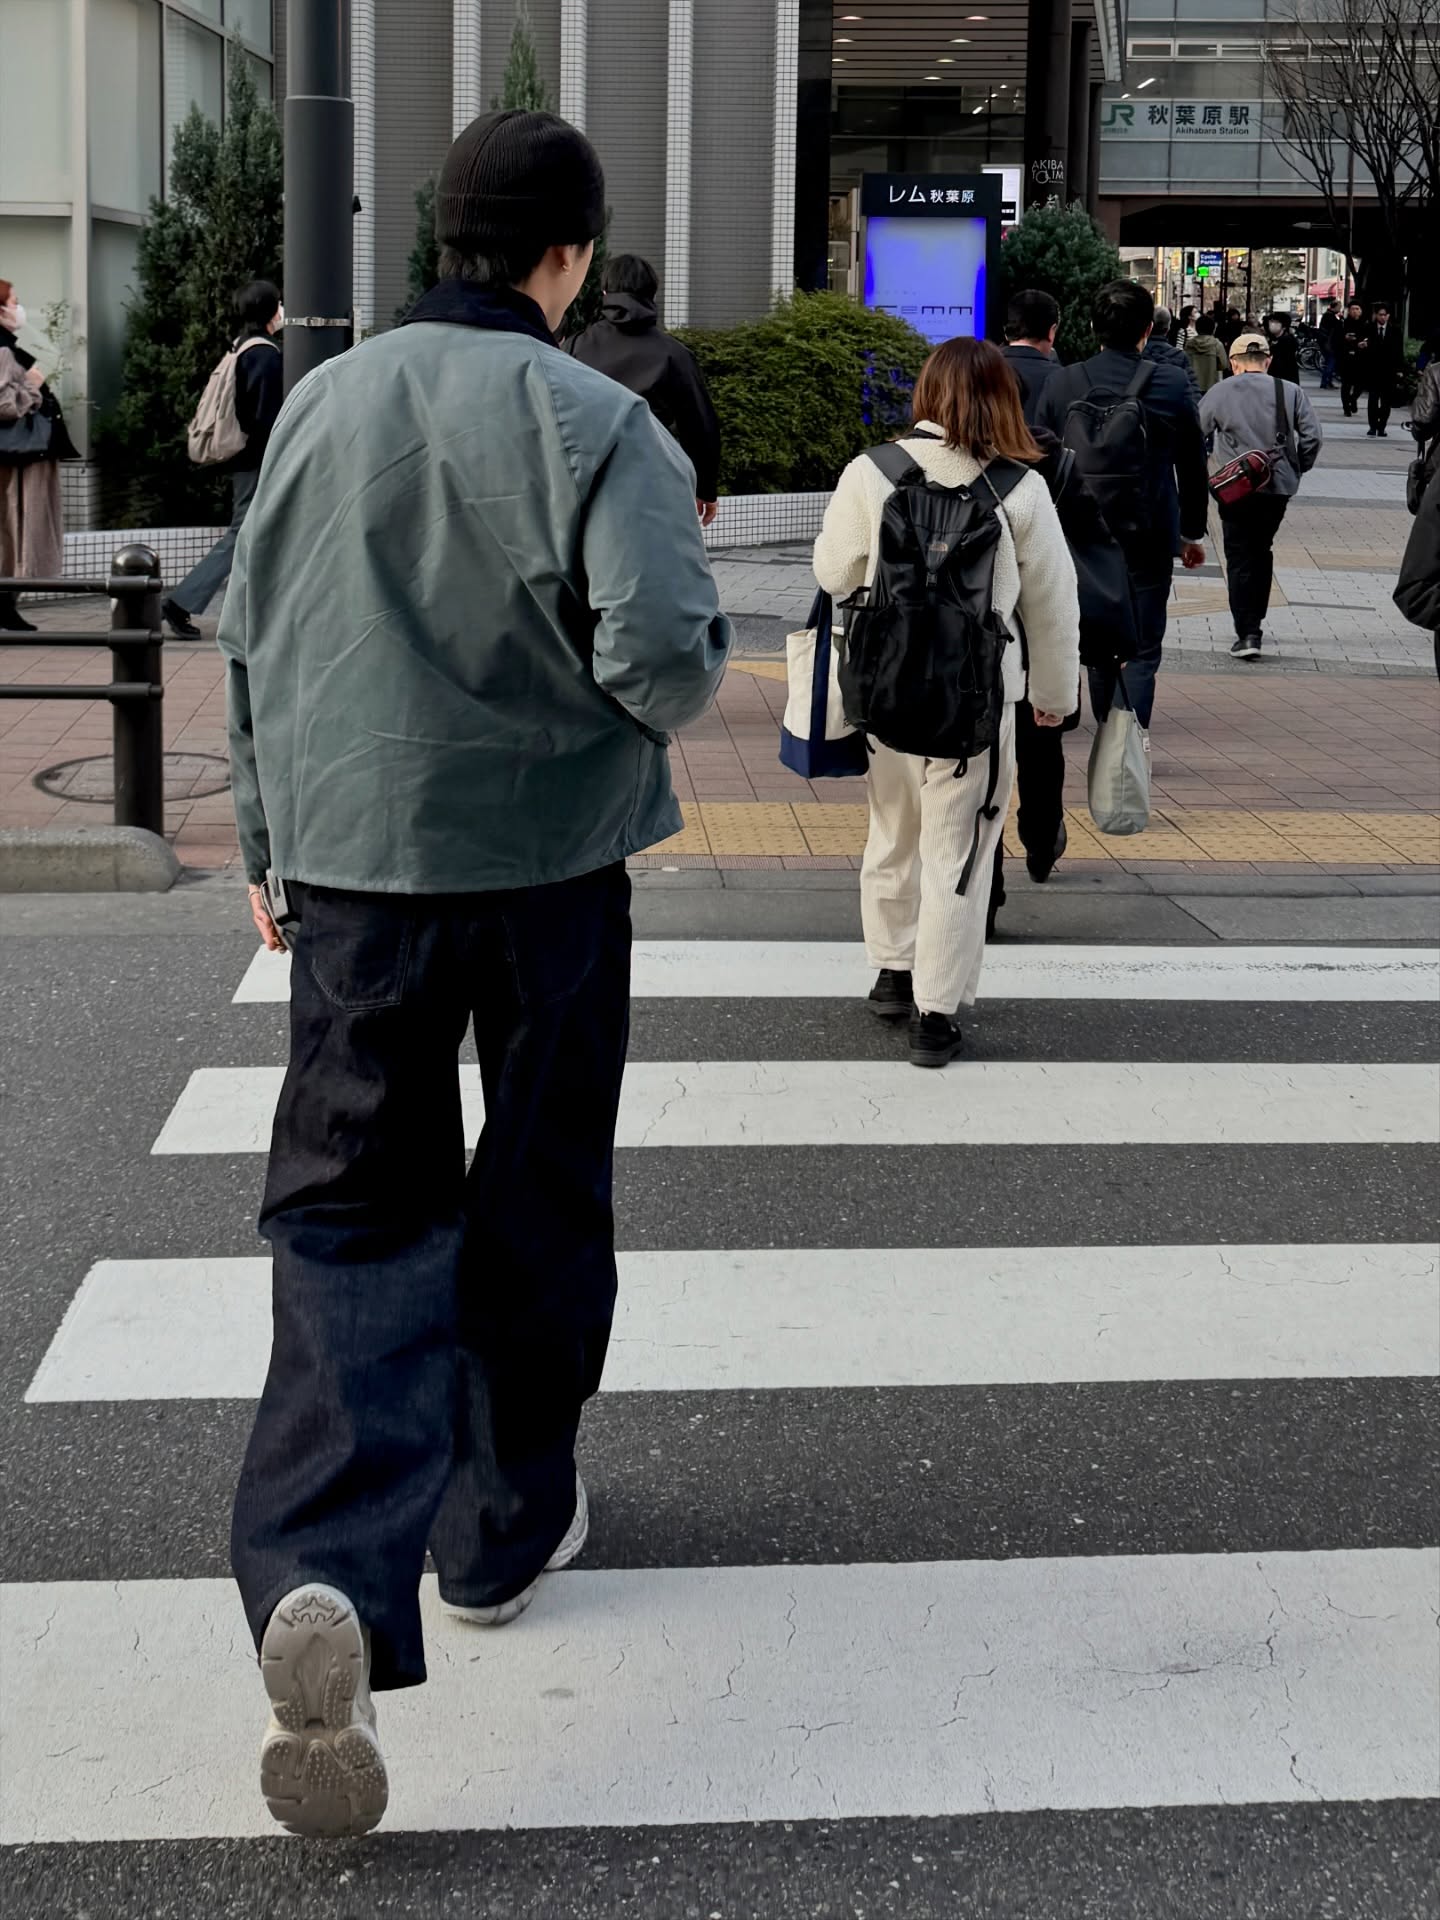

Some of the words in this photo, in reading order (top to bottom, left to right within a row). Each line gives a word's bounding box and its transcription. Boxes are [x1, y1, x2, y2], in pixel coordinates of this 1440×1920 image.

[1101, 104, 1135, 126] JR
[1148, 105, 1249, 126] 秋葉原駅
[1175, 127, 1216, 135] Akihabara
[1219, 127, 1249, 135] Station
[1031, 159, 1064, 170] AKIBA
